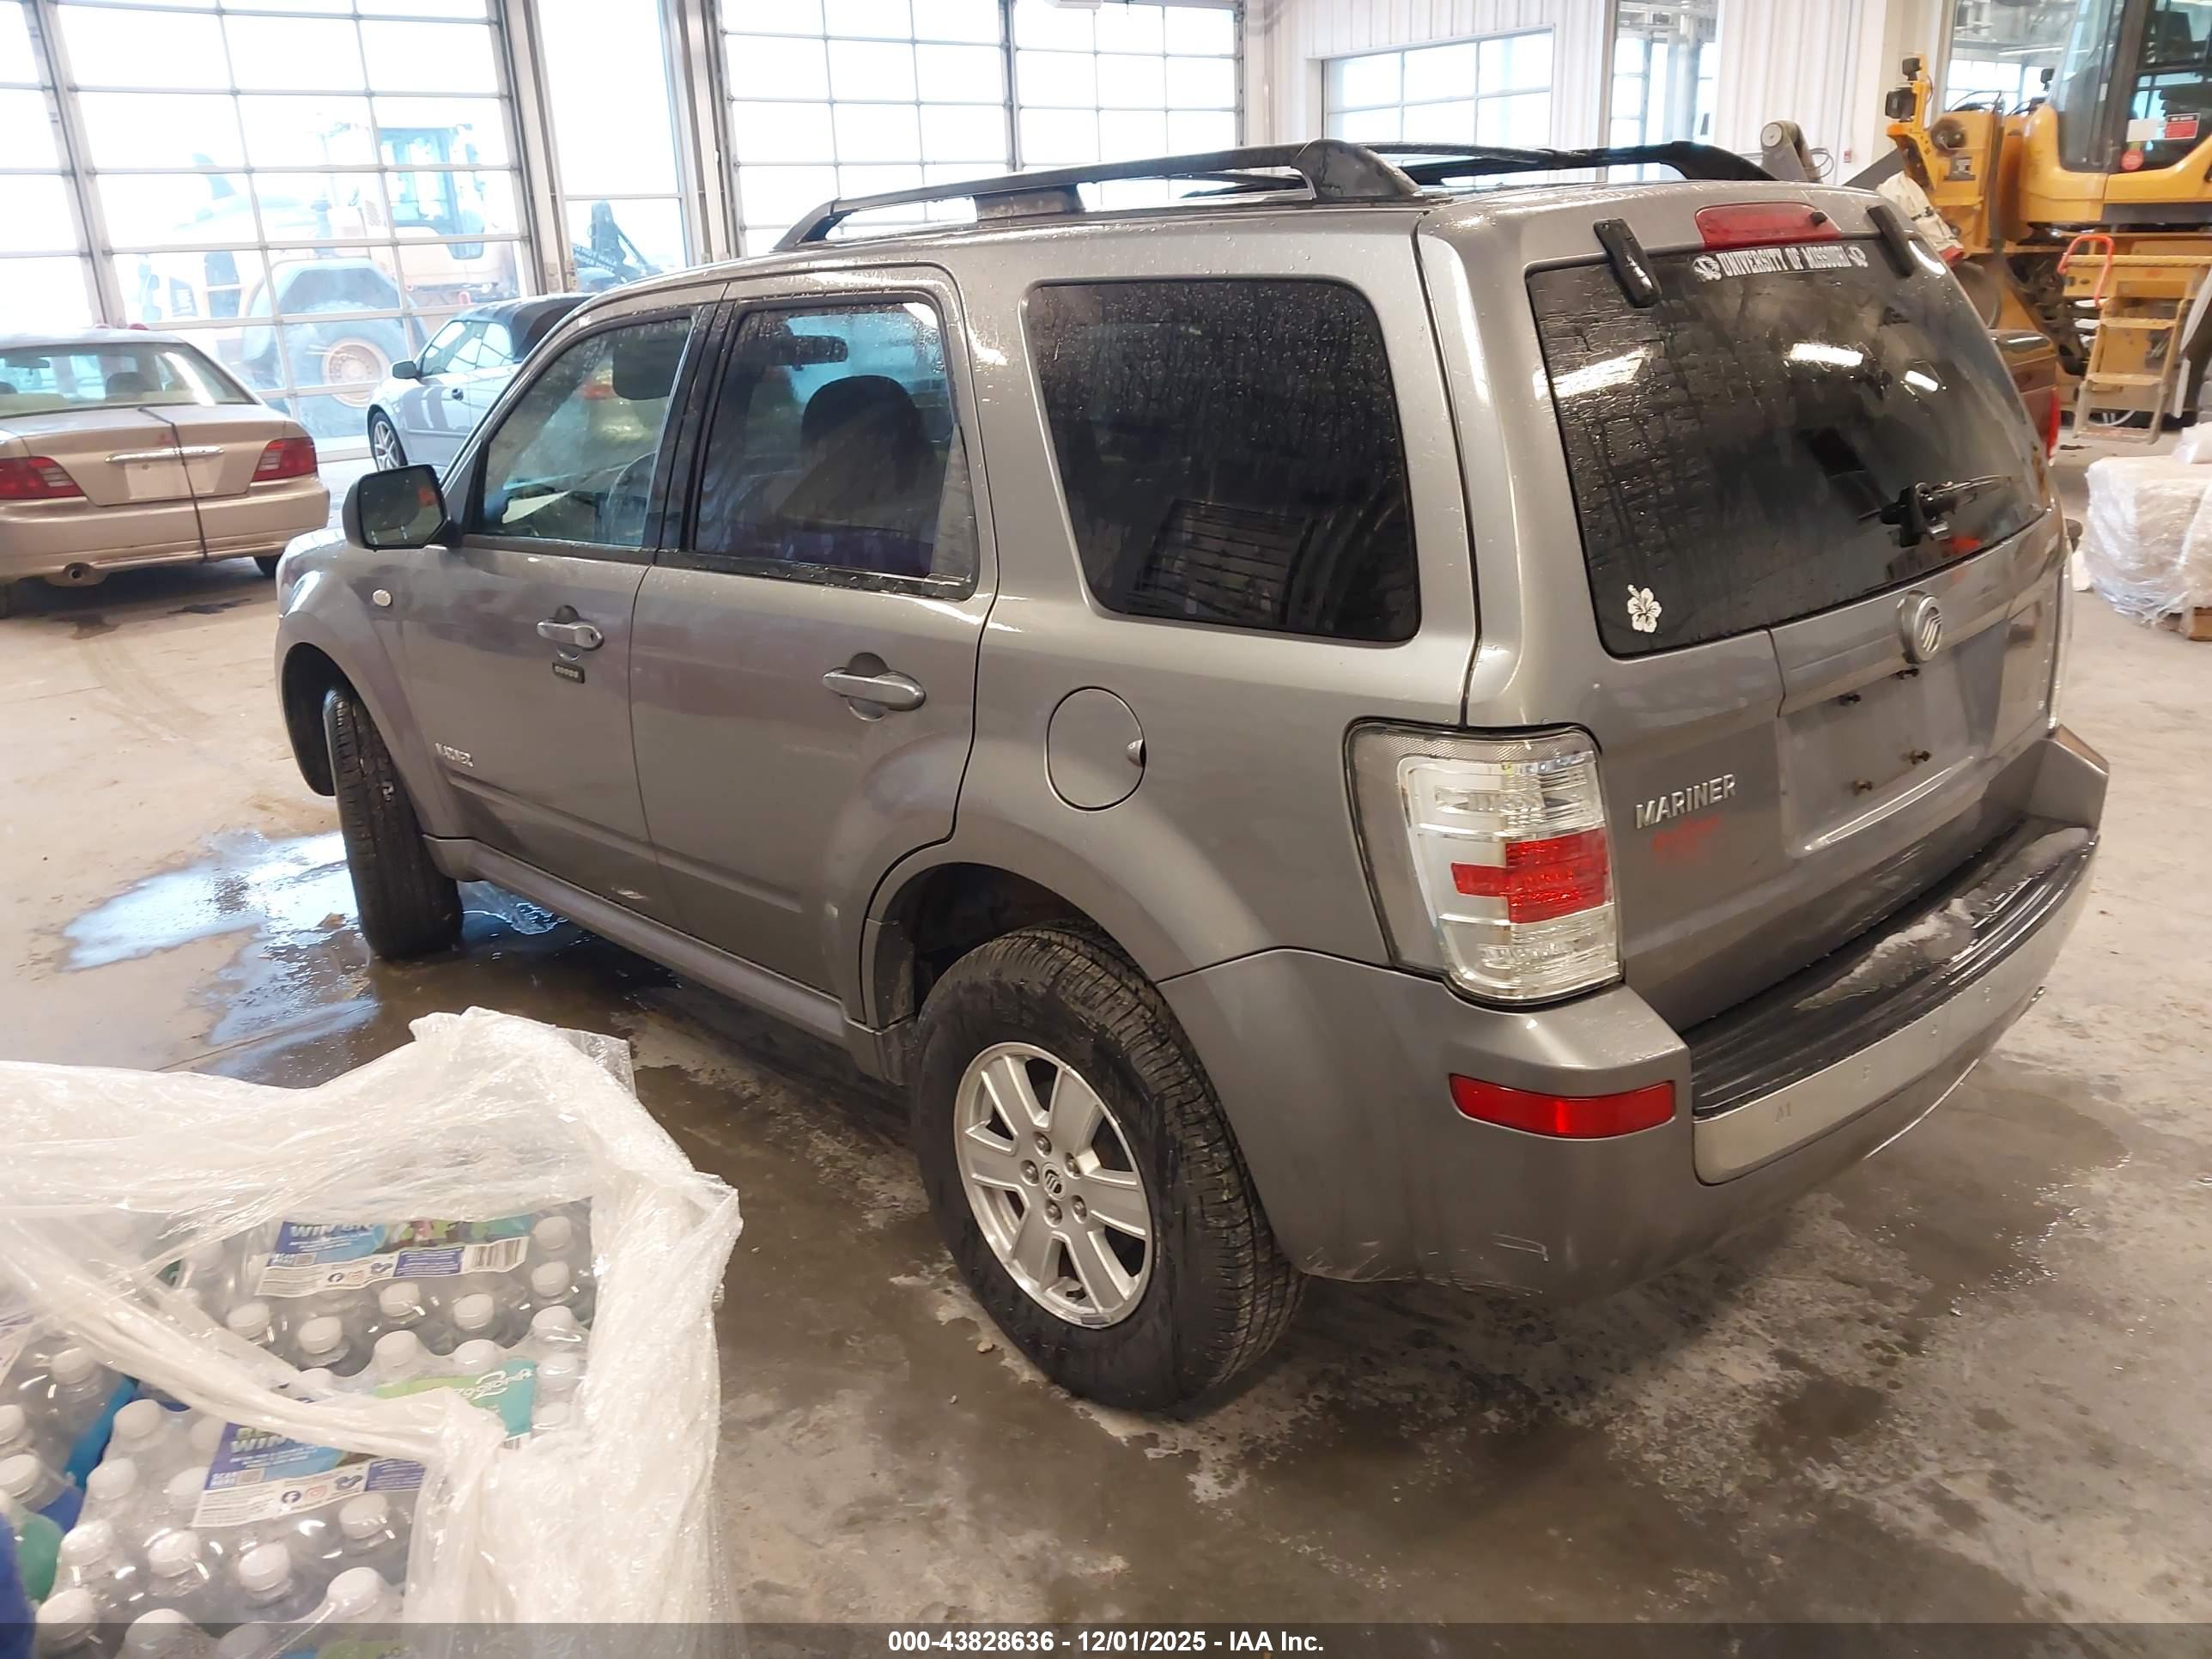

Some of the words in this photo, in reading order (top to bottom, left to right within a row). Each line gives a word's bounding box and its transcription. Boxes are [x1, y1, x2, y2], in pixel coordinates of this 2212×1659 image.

[1716, 248, 1789, 276] UNIVERSITY
[1785, 246, 1804, 270] OF
[1635, 773, 1736, 830] MARINER
